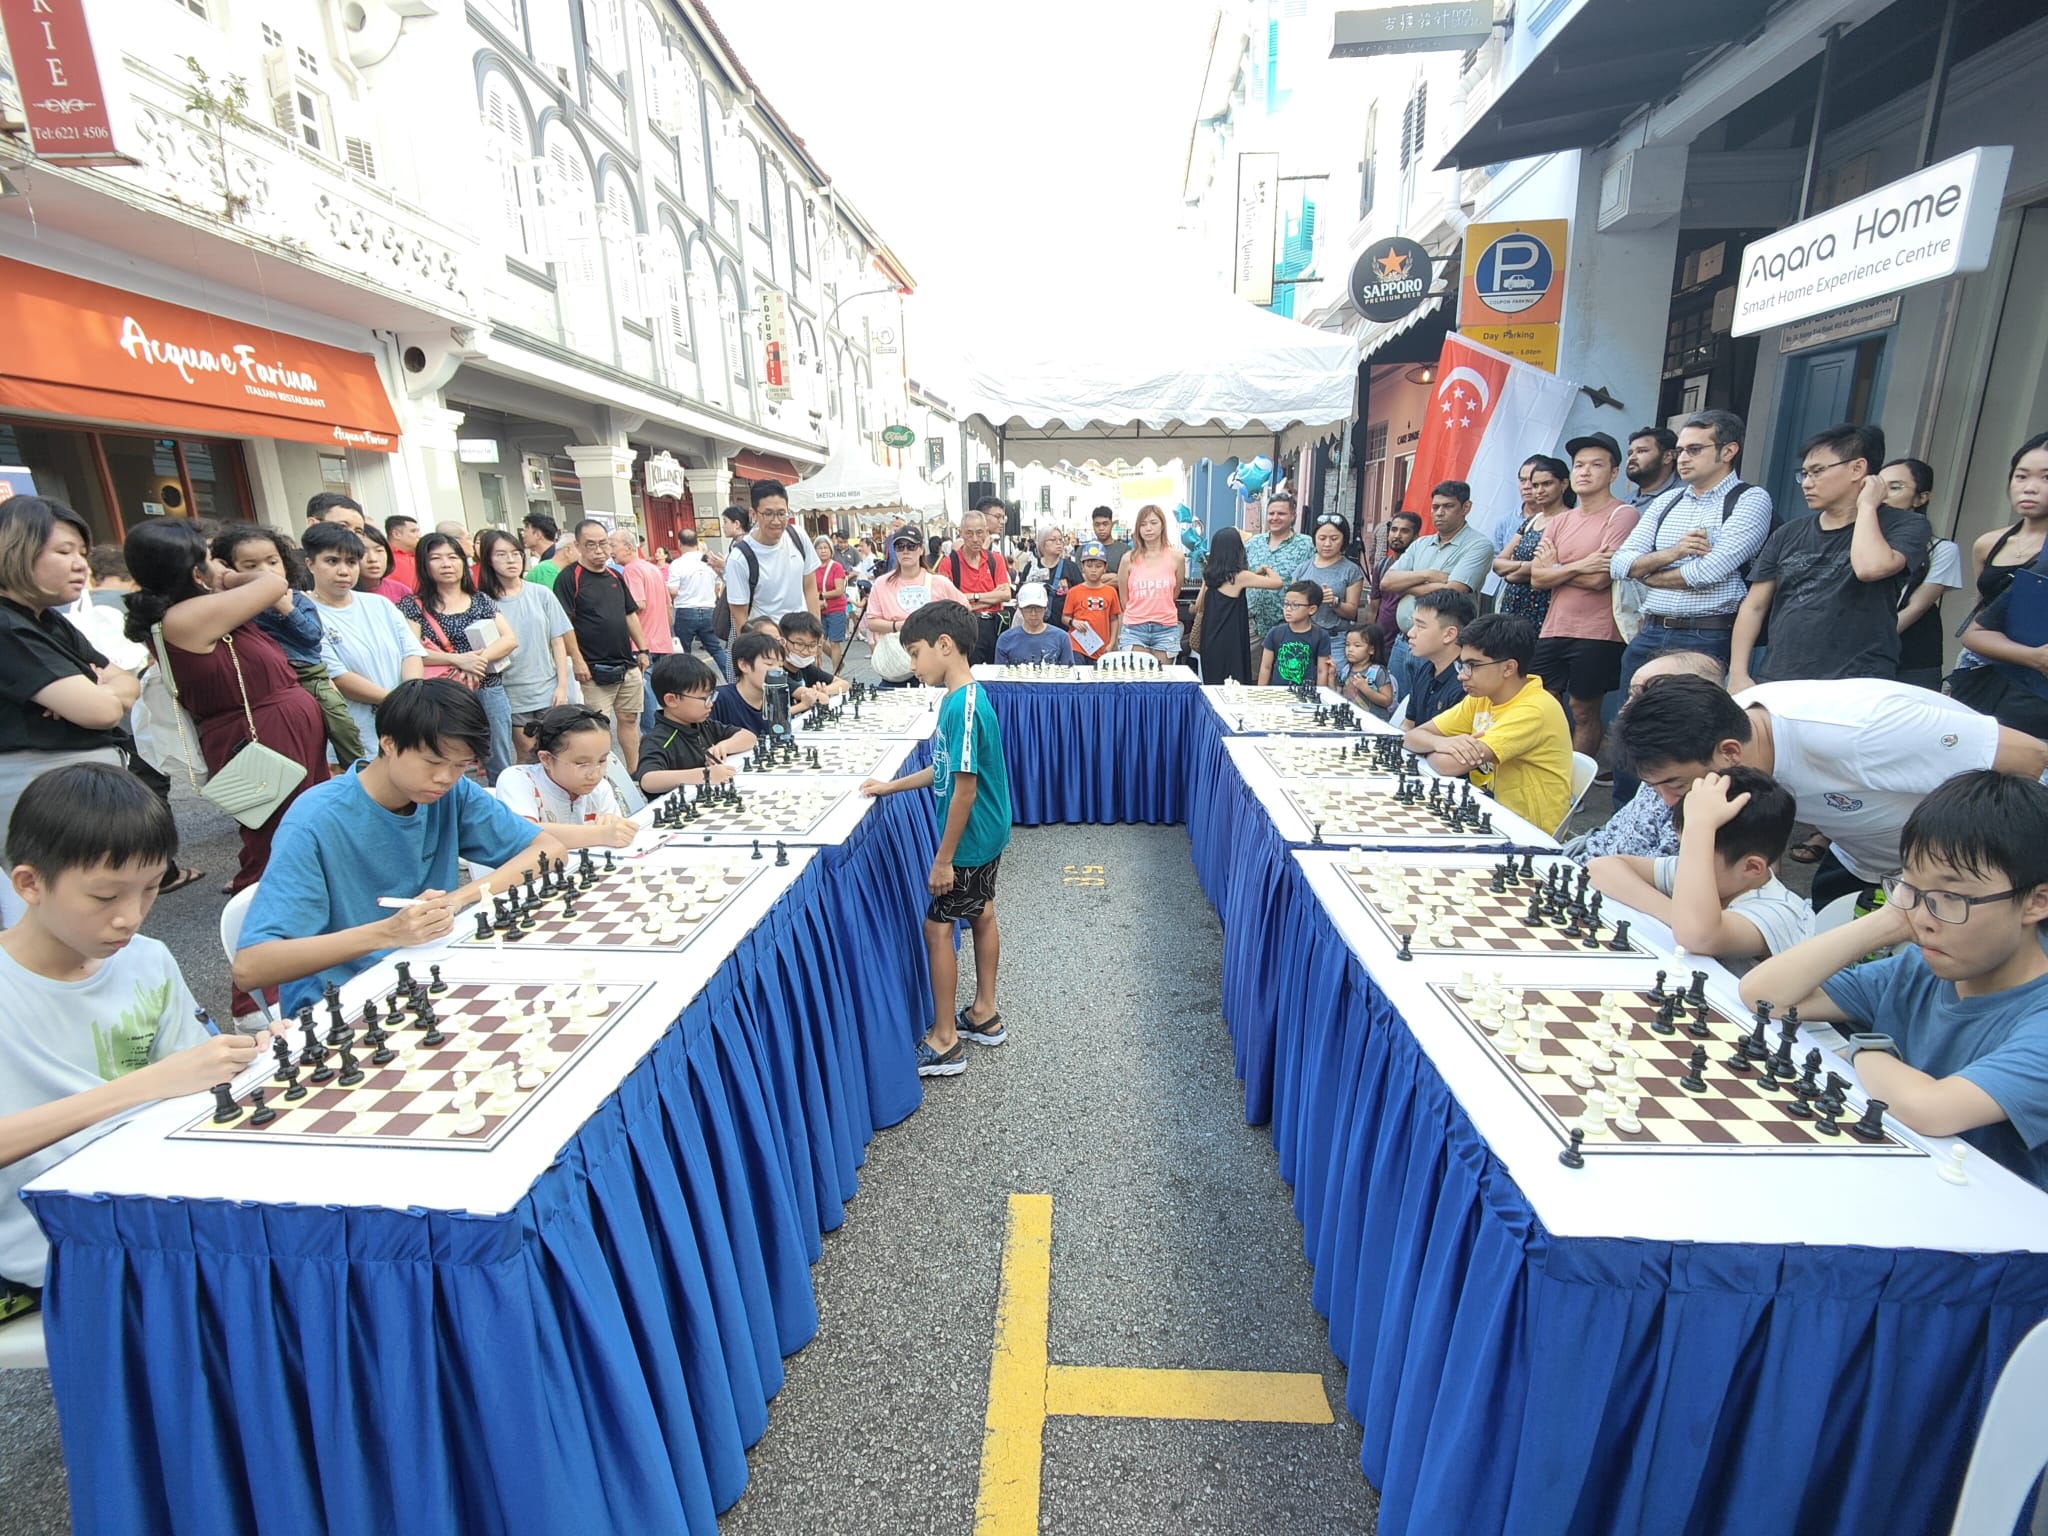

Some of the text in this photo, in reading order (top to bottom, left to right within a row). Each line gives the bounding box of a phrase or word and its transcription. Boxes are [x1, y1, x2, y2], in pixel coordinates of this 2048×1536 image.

[55, 127, 80, 139] 6221
[83, 127, 108, 139] 4506
[1746, 184, 1962, 288] Aqara Home
[1742, 237, 1951, 316] Smart Home Experience Centre
[1363, 278, 1423, 299] SAPPORO
[1365, 291, 1421, 305] PREMIUM BEER
[762, 295, 773, 341] FOCUS
[1483, 331, 1535, 341] Day Parking
[120, 316, 317, 392] Acqua e Farina
[767, 344, 776, 384] MUSIC
[244, 384, 278, 400] ITALIAN
[651, 463, 684, 488] KILLINEY
[837, 490, 847, 498] AND
[1132, 579, 1170, 589] SUPER
